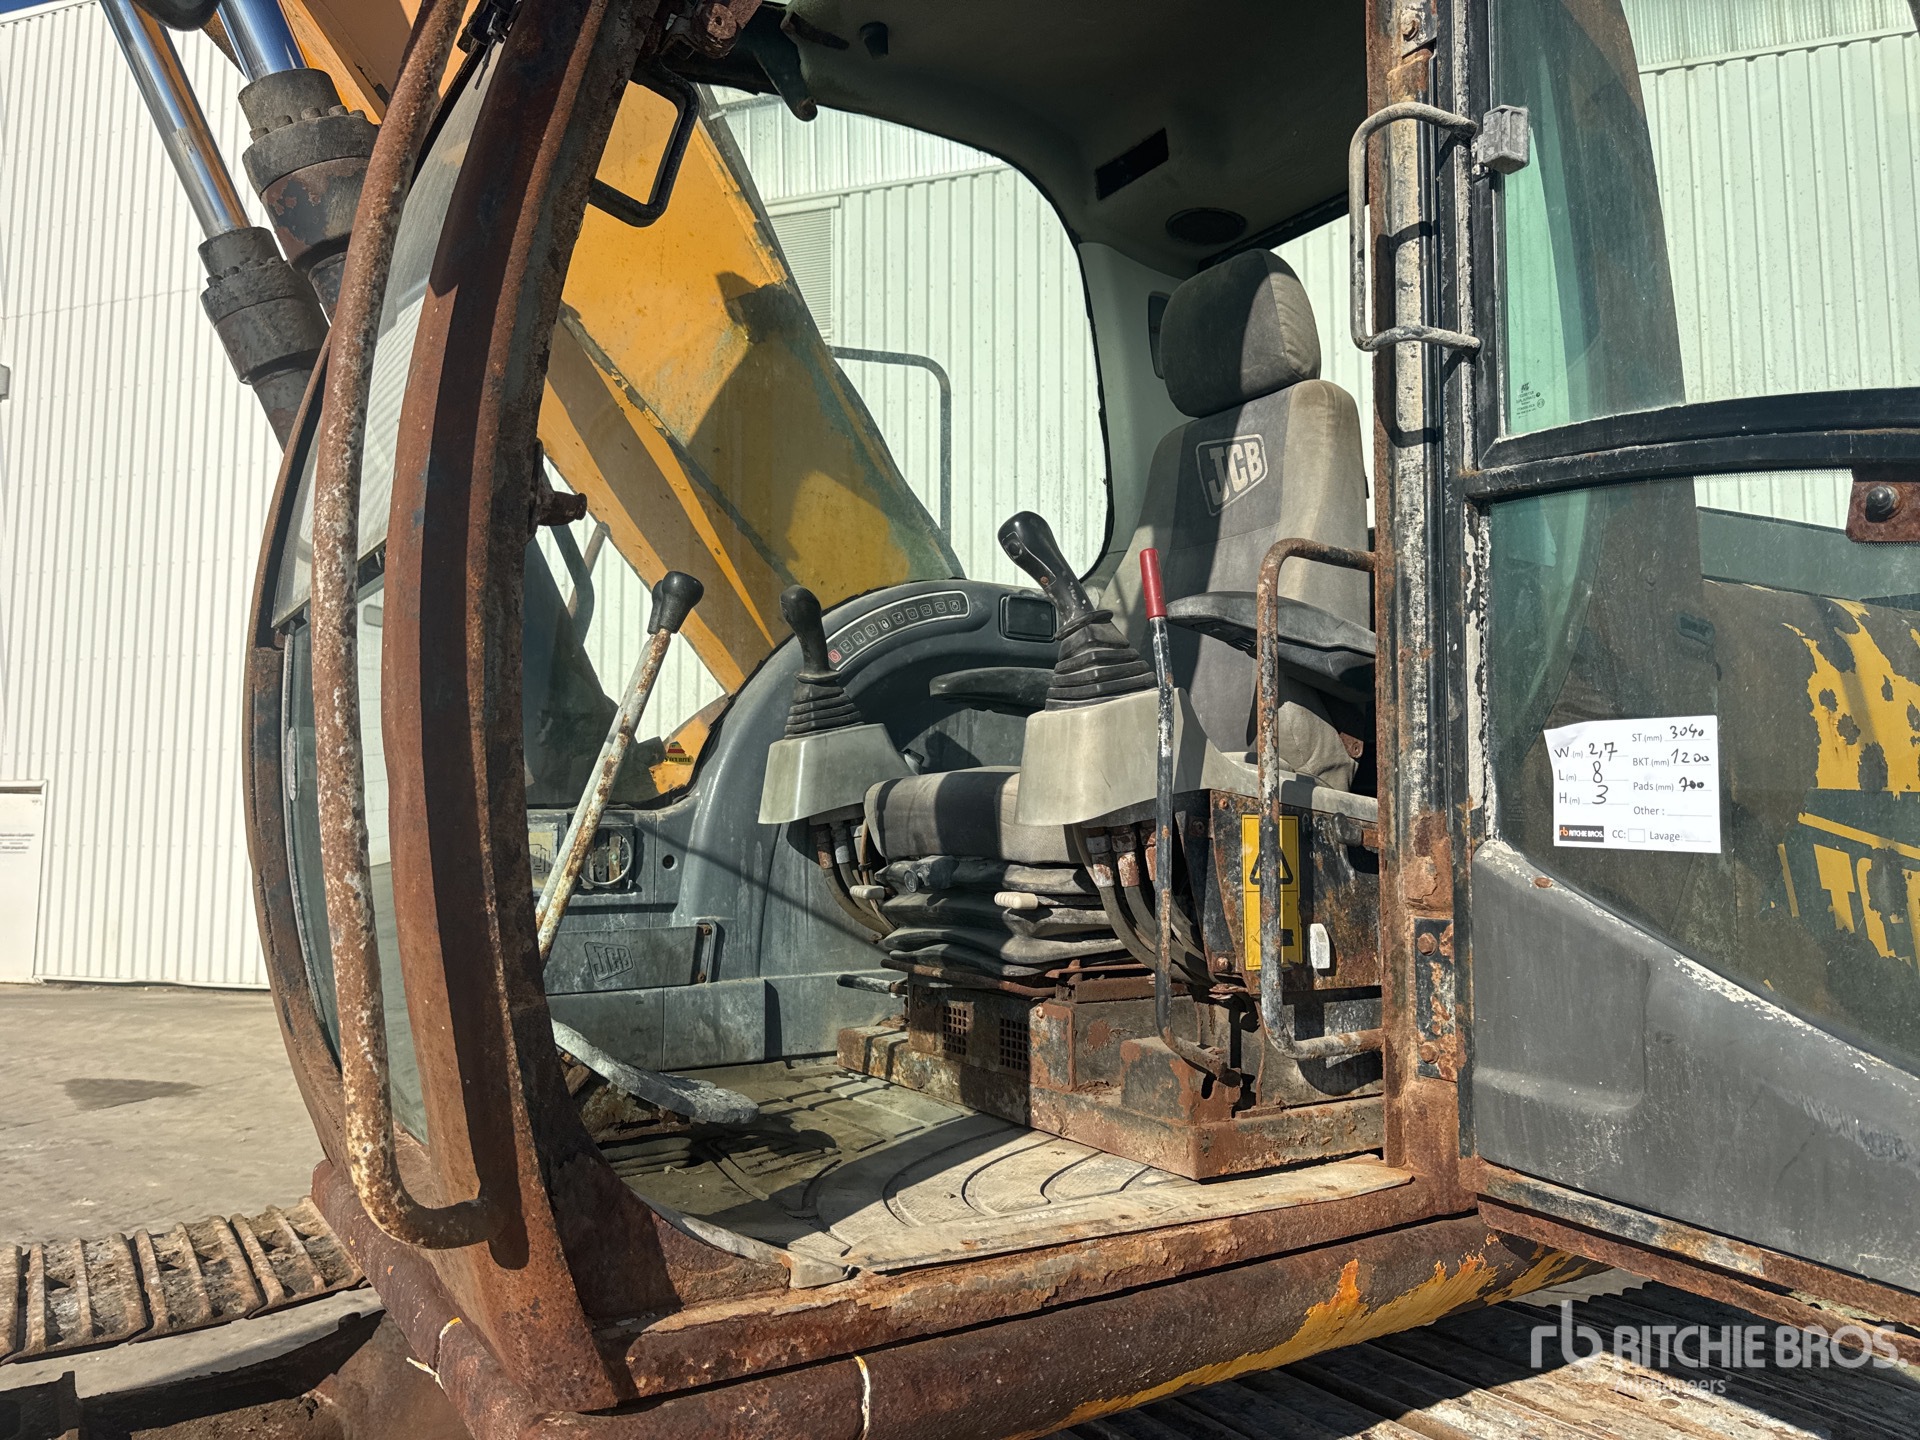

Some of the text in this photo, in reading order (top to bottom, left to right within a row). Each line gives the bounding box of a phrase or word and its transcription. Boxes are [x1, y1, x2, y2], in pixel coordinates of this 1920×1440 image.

[1208, 441, 1263, 506] JCB
[1632, 733, 1642, 742] ST
[1669, 723, 1704, 739] 3040
[1554, 746, 1570, 759] W
[1588, 742, 1618, 762] 2,7
[1633, 758, 1649, 766] BKT
[1670, 748, 1710, 765] 1200
[1559, 769, 1566, 781] L
[1592, 760, 1603, 784] 8
[1559, 792, 1568, 804] H
[1591, 784, 1609, 805] 3
[1633, 782, 1654, 791] Pads
[1655, 784, 1674, 792] (mm)
[1633, 806, 1660, 816] Other
[1612, 830, 1626, 839] CC:
[591, 943, 631, 978] JCB
